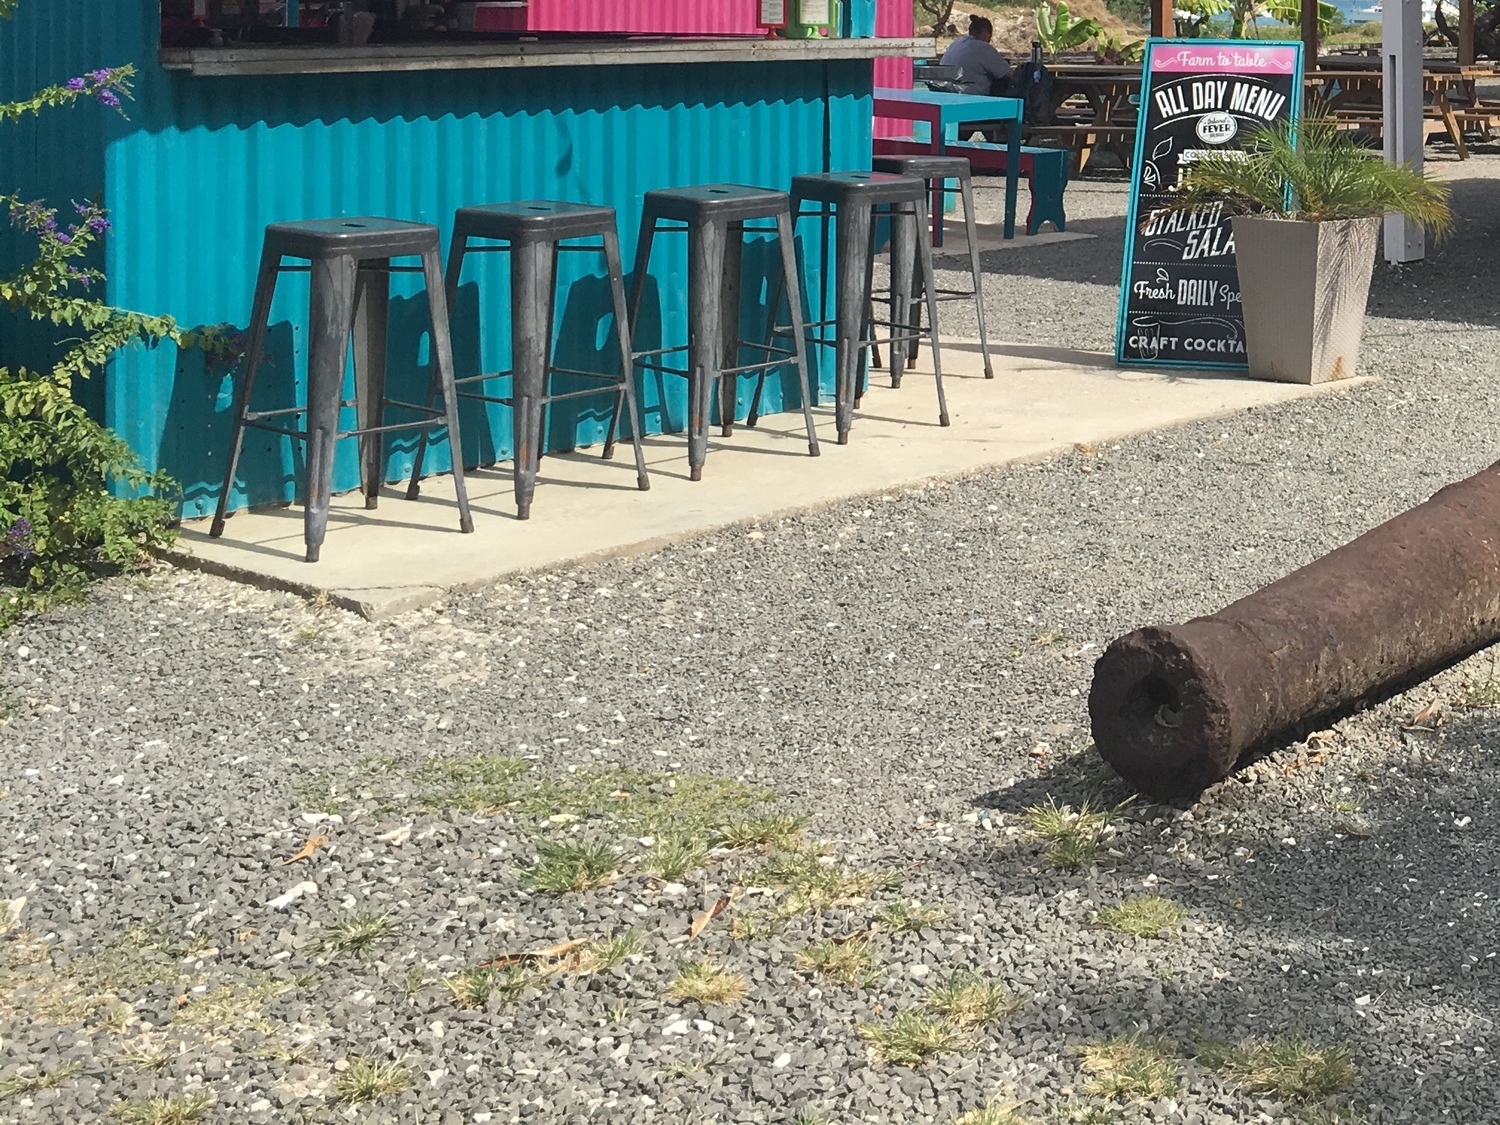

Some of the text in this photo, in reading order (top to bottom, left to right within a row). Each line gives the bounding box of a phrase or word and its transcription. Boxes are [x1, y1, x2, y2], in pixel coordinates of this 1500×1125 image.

[1177, 51, 1267, 67] Farm to table
[1155, 81, 1286, 121] ALL DAY MENU
[1203, 124, 1231, 133] FEVER
[1182, 227, 1236, 260] SALA
[1134, 281, 1175, 300] Fresh
[1177, 279, 1218, 306] DAILY
[1129, 336, 1245, 353] CRAFT COCKTA
